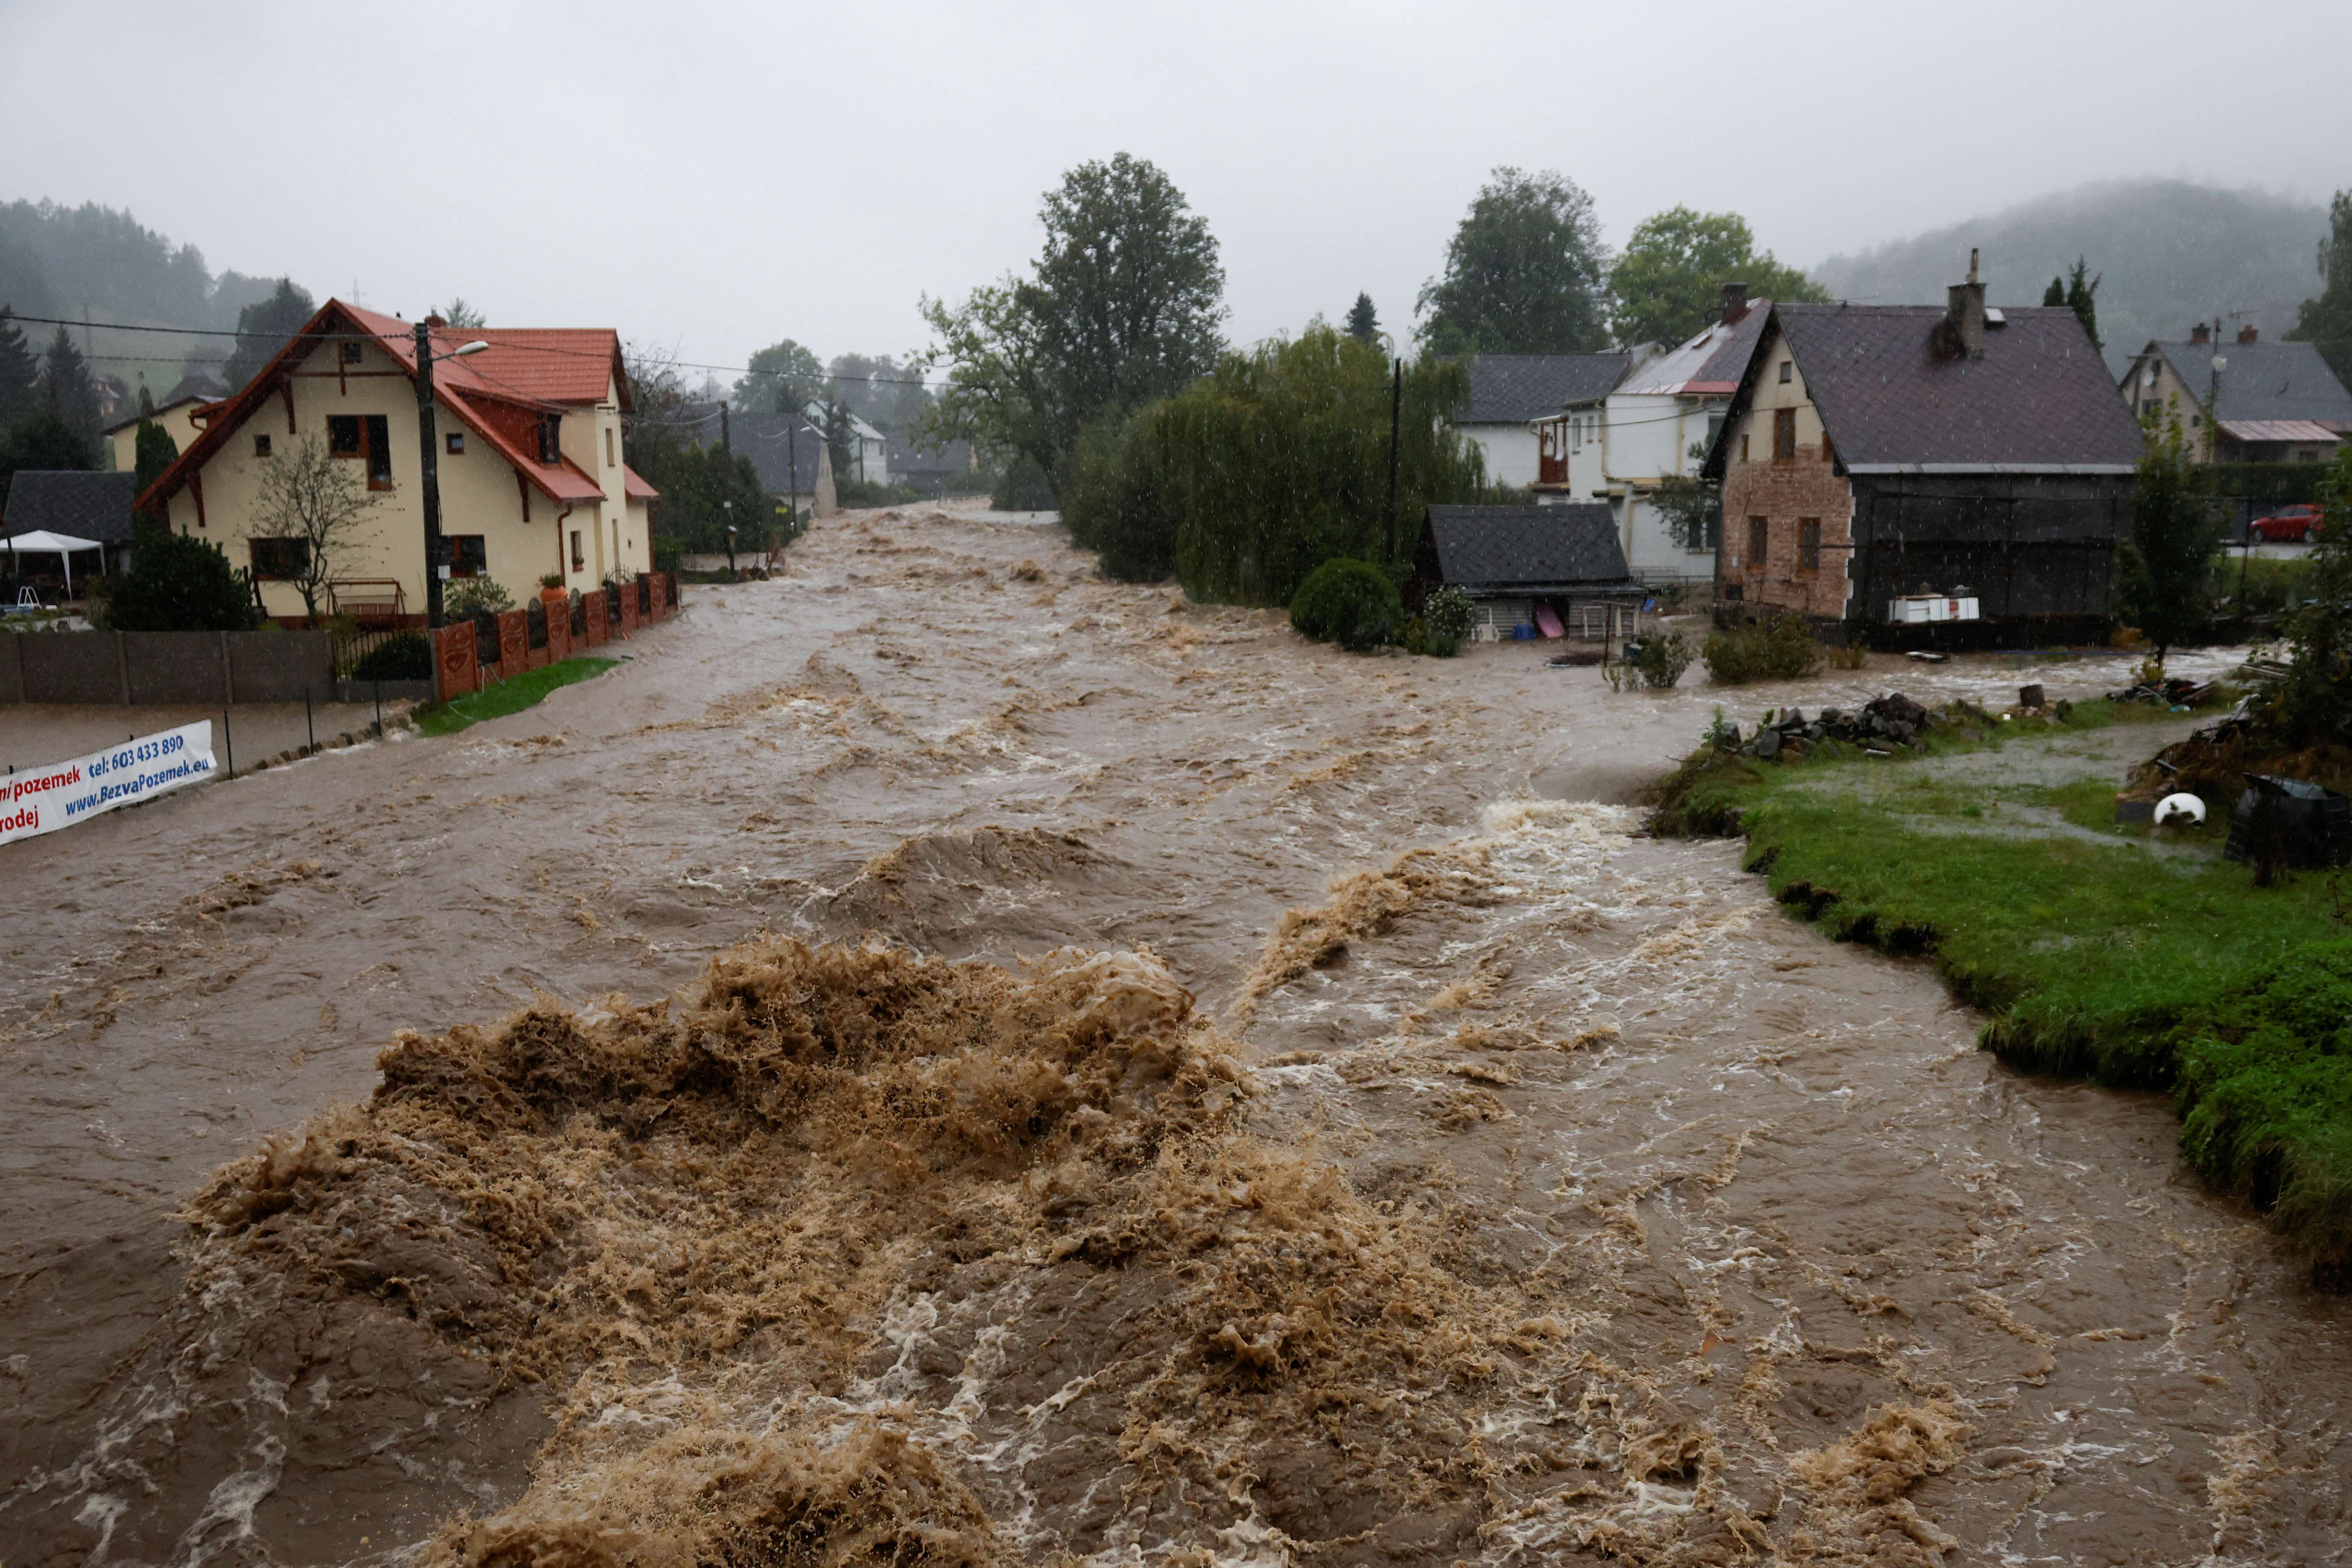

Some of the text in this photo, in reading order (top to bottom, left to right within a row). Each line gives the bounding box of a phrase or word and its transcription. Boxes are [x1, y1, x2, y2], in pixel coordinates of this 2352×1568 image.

[89, 735, 183, 778] tel: 603 433 890
[14, 765, 80, 802] pozemek
[66, 759, 209, 815] www.BezvaPozemek.eu
[0, 805, 38, 833] rodej
